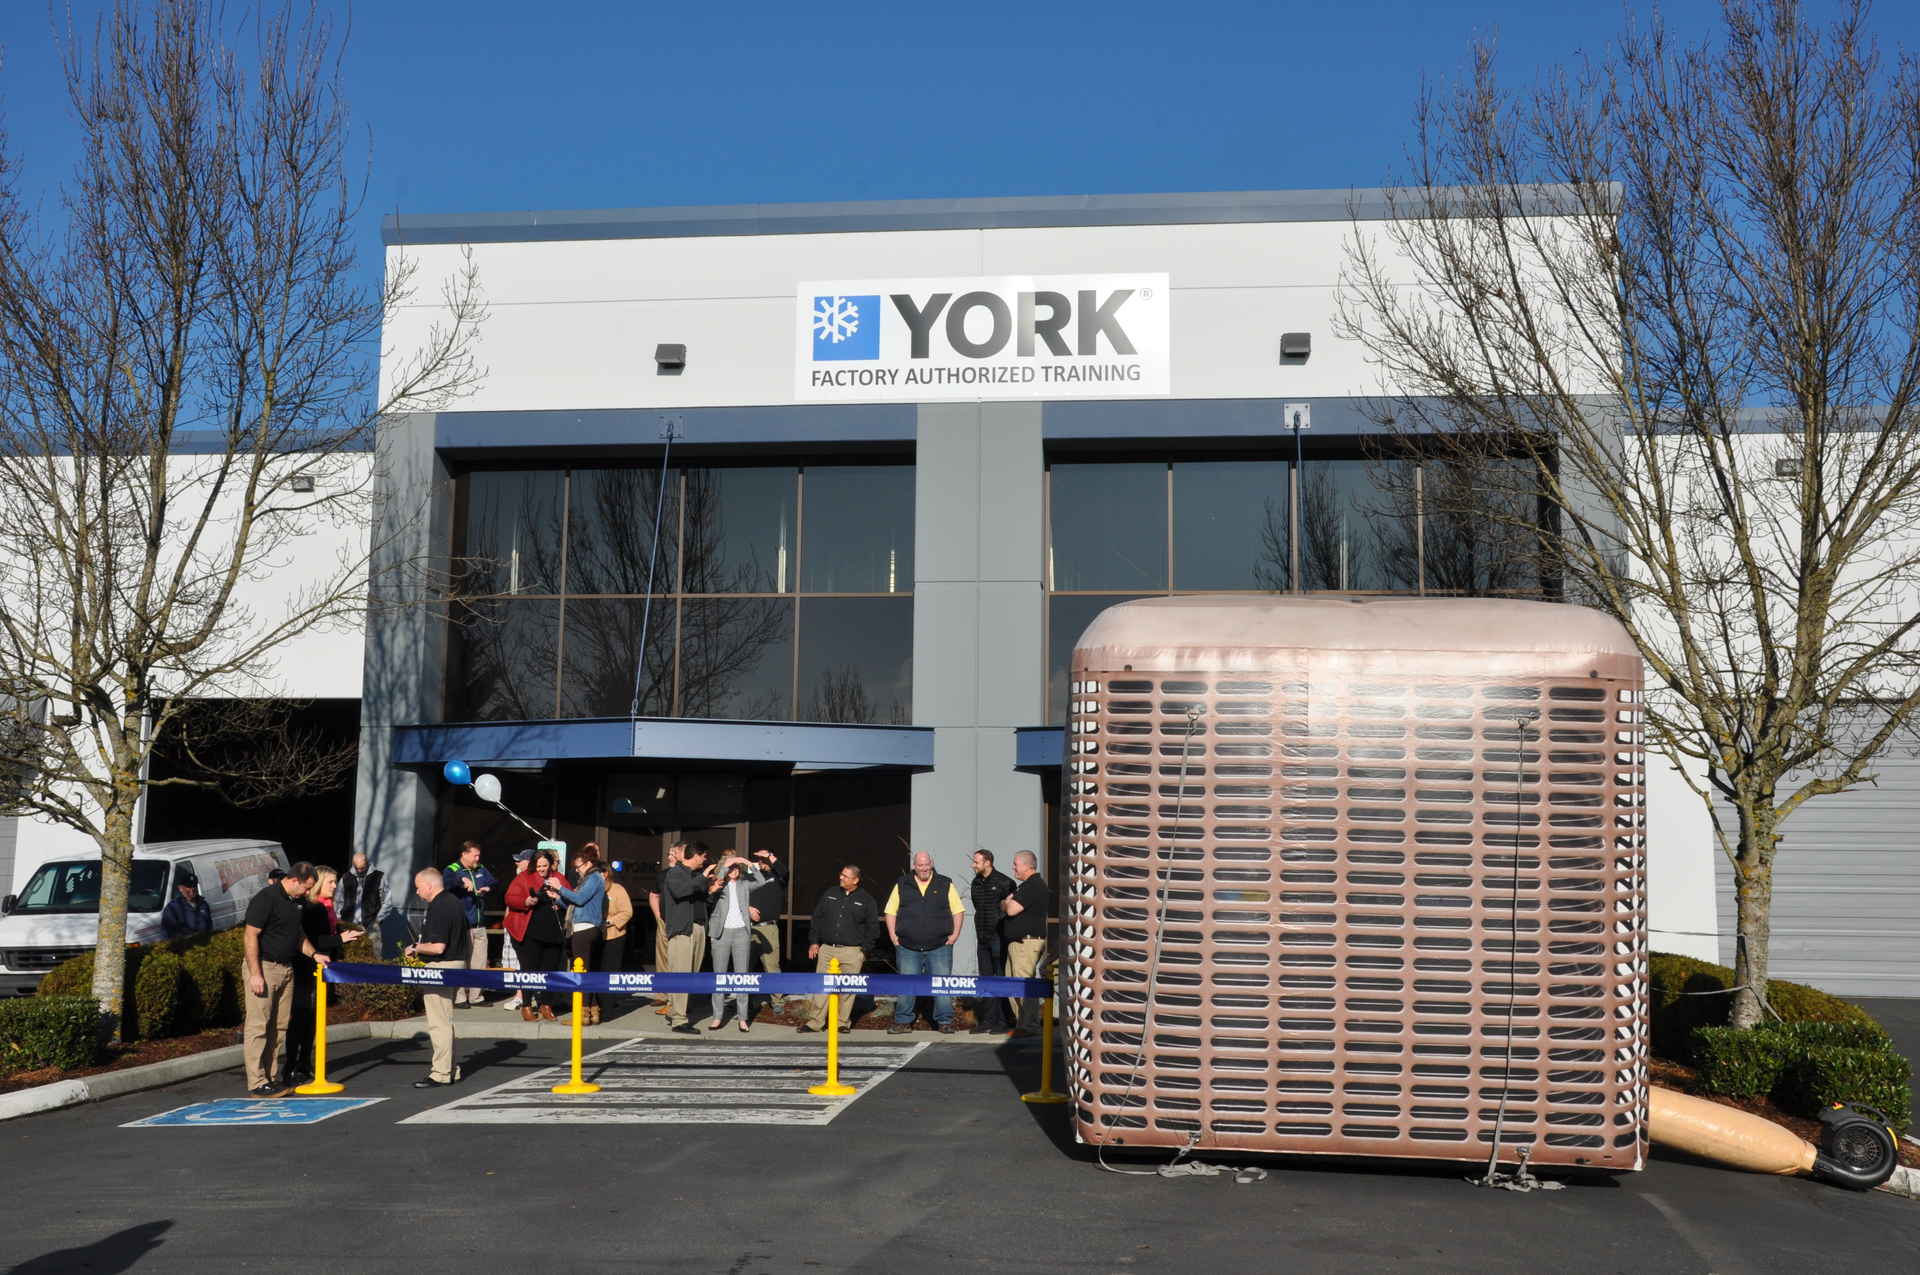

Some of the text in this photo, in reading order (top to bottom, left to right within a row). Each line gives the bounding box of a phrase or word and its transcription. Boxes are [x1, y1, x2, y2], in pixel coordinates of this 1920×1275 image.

[889, 289, 1138, 359] YORK
[811, 364, 1141, 387] FACTORY AUTHORIZED TRAINING
[411, 968, 443, 979] YORK
[514, 972, 547, 983] YORK
[620, 974, 653, 985] YORK
[726, 974, 760, 985] YORK
[834, 975, 867, 986] YORK
[942, 976, 977, 988] YORK
